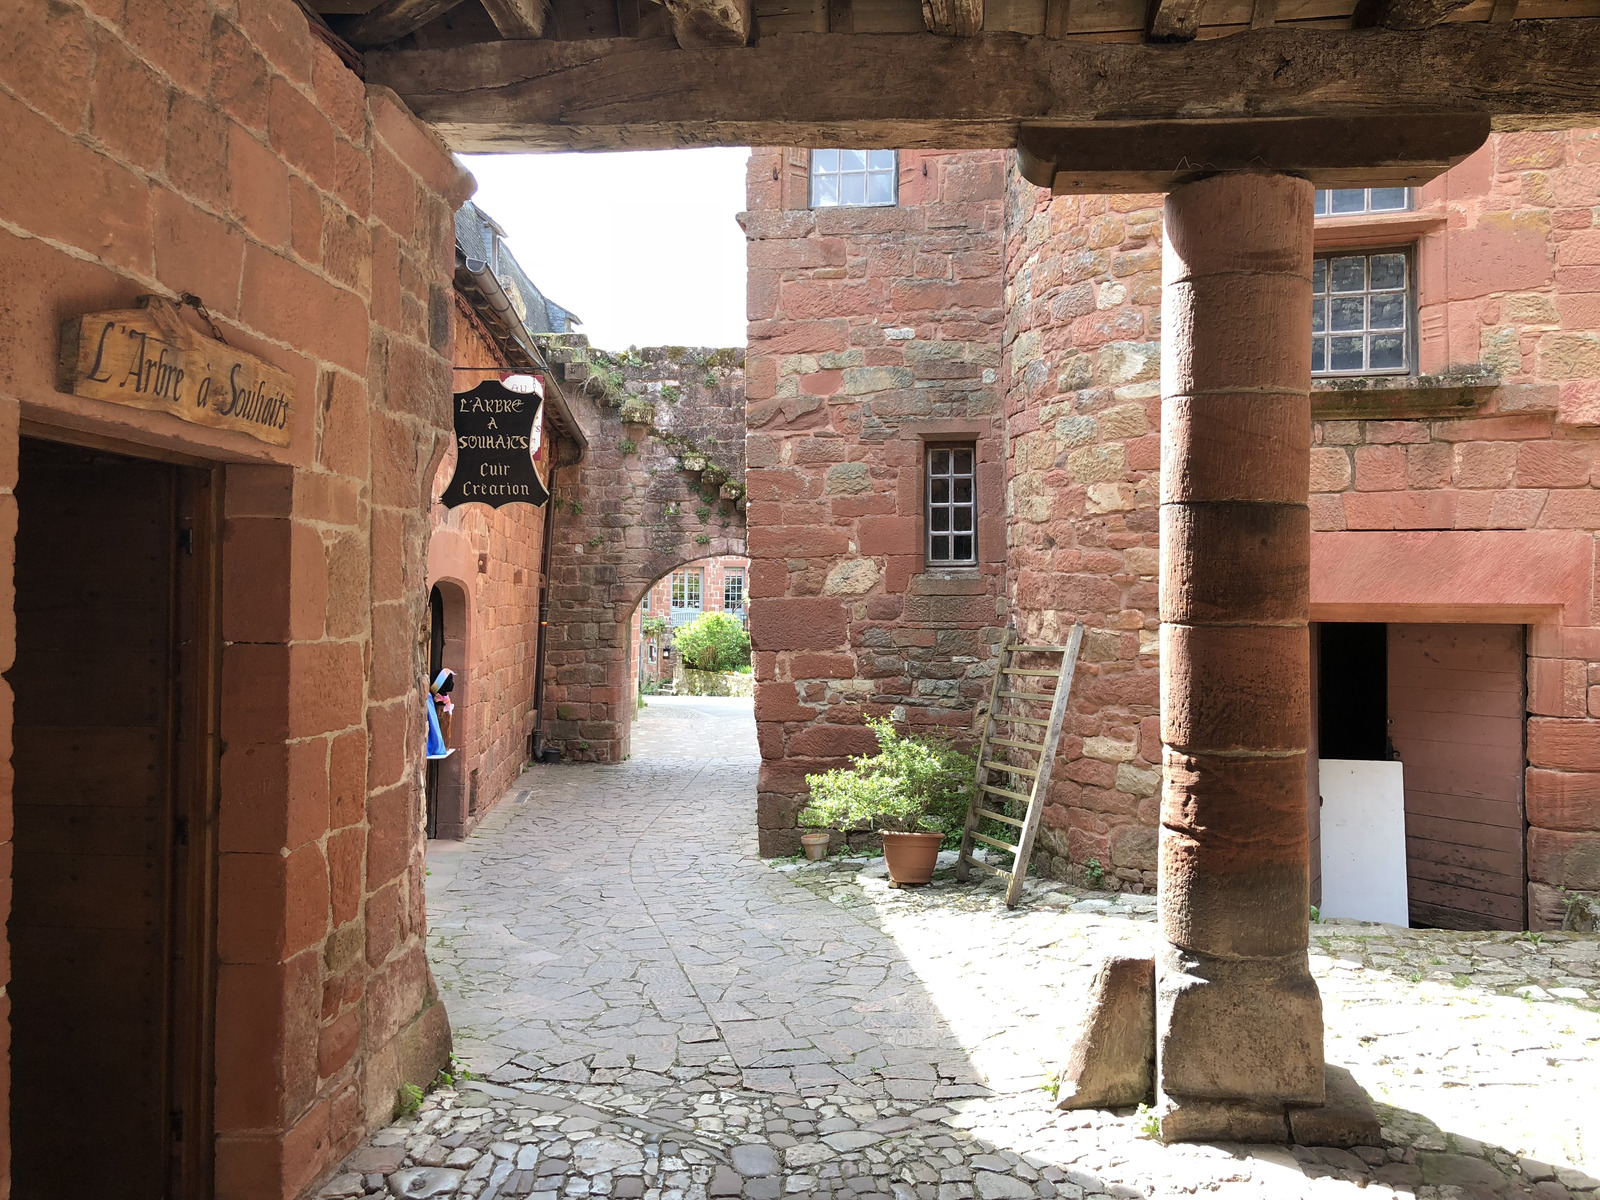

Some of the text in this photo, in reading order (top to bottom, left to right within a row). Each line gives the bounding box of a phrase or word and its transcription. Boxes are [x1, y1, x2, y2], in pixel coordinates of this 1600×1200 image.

[87, 321, 185, 402] L'Arbre
[219, 363, 290, 430] Souhaits
[459, 397, 524, 413] L'ARBRE
[487, 416, 498, 430] A
[458, 433, 529, 450] SOUHAITS
[480, 462, 511, 477] Cuir
